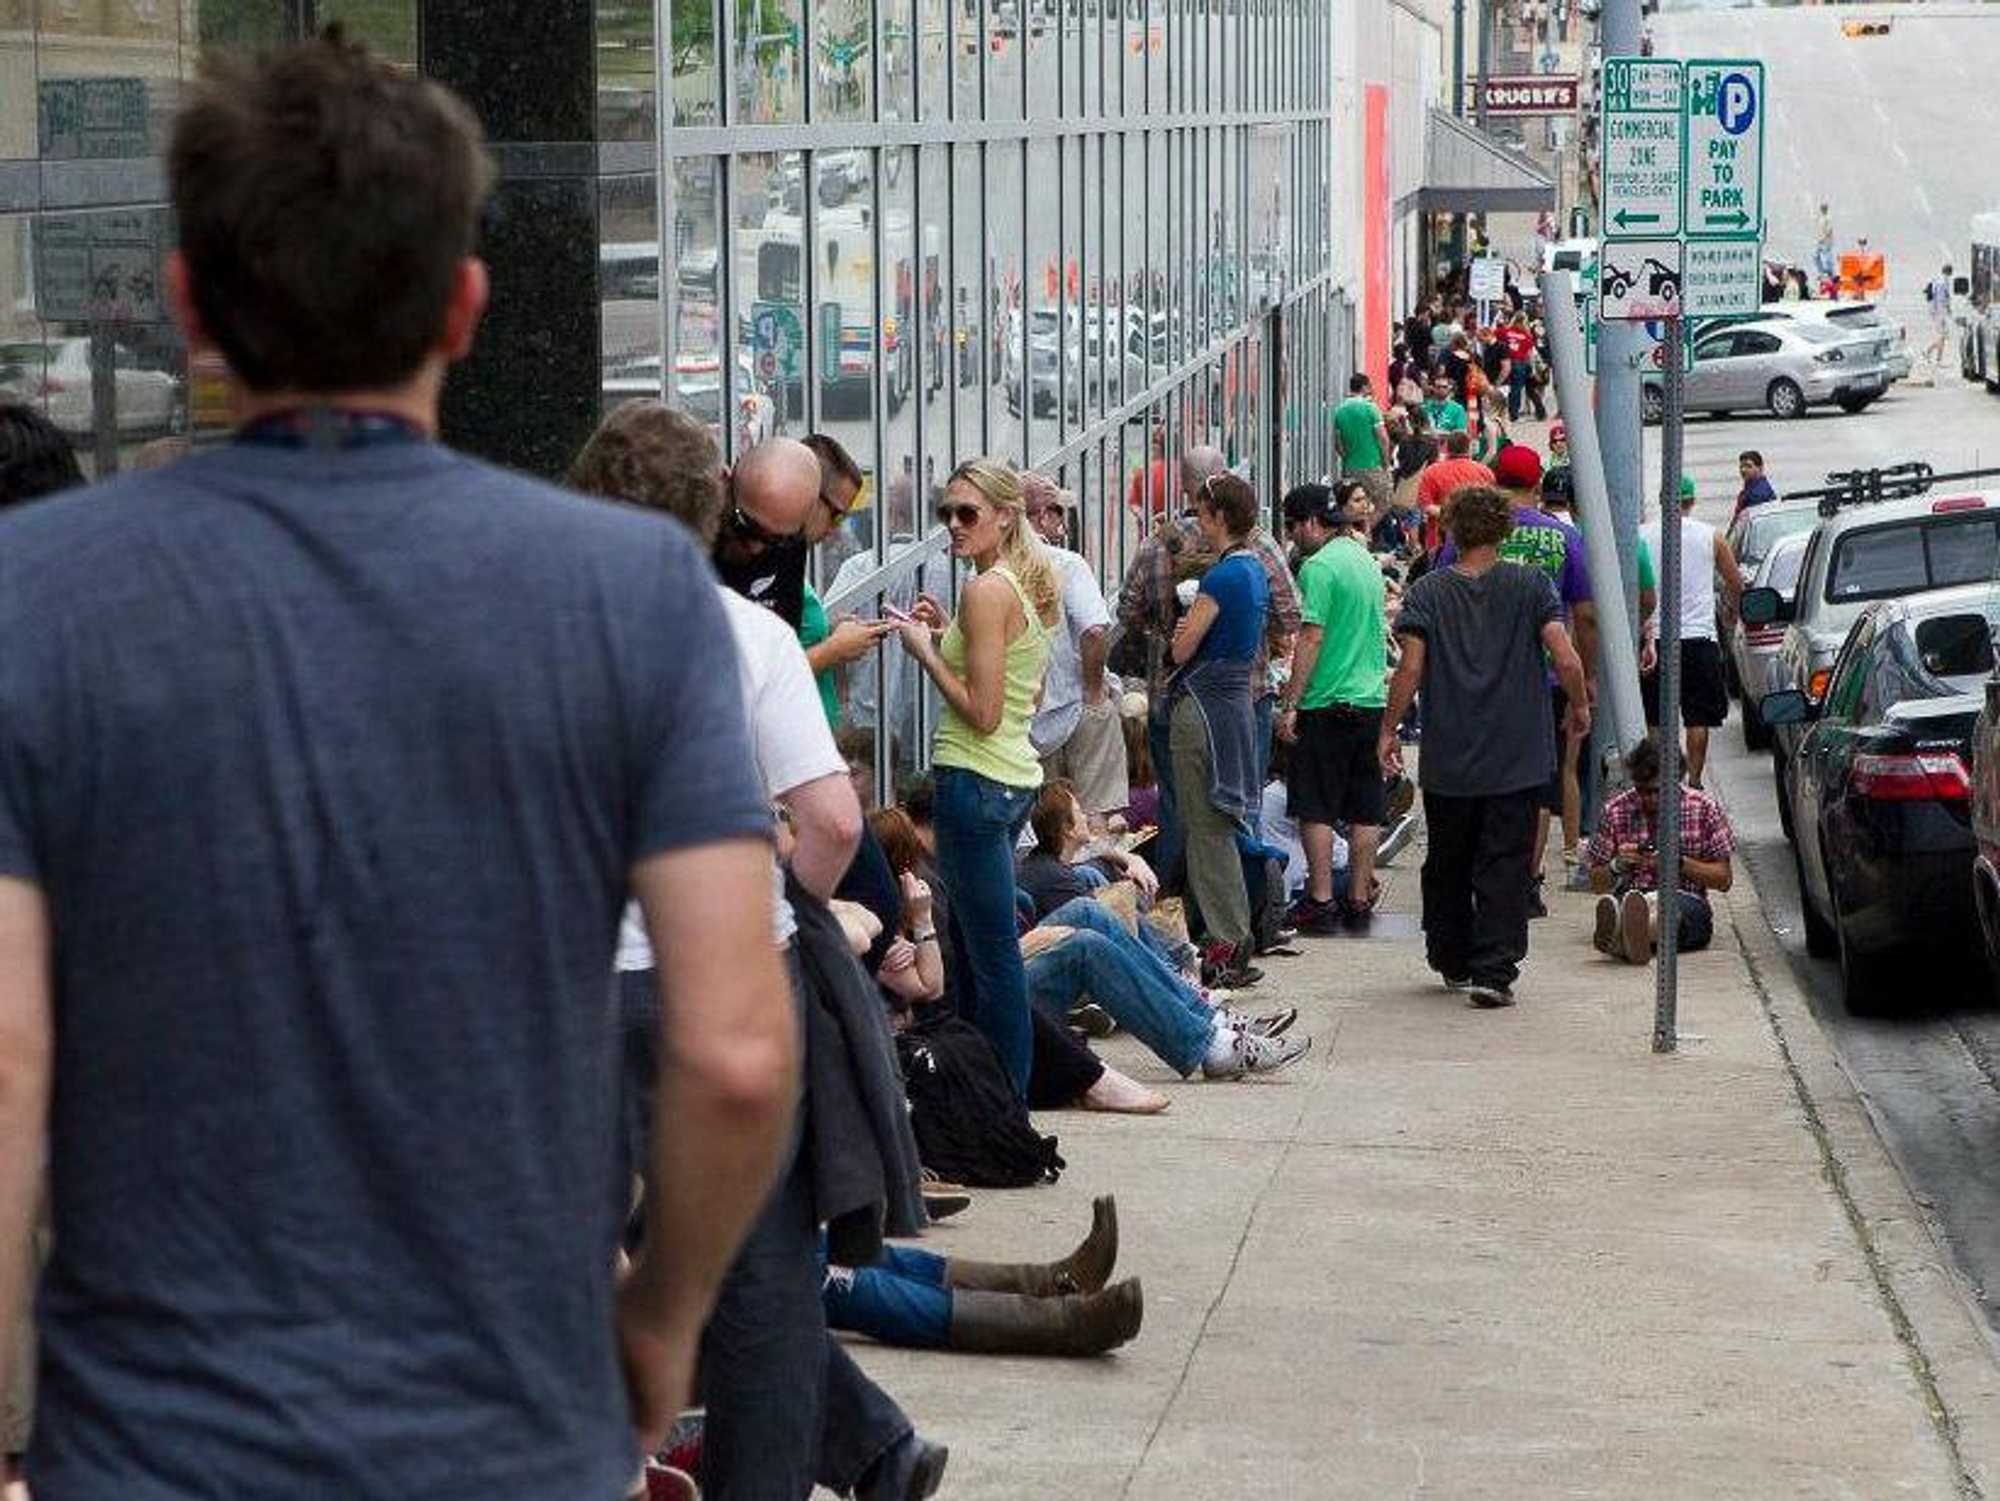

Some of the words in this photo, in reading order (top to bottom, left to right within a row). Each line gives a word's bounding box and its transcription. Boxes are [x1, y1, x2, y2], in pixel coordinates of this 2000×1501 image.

[1607, 64, 1628, 94] 30
[1630, 146, 1656, 167] ZONE
[1709, 139, 1738, 159] PAY
[1712, 164, 1733, 184] TO
[1702, 187, 1743, 207] PARK
